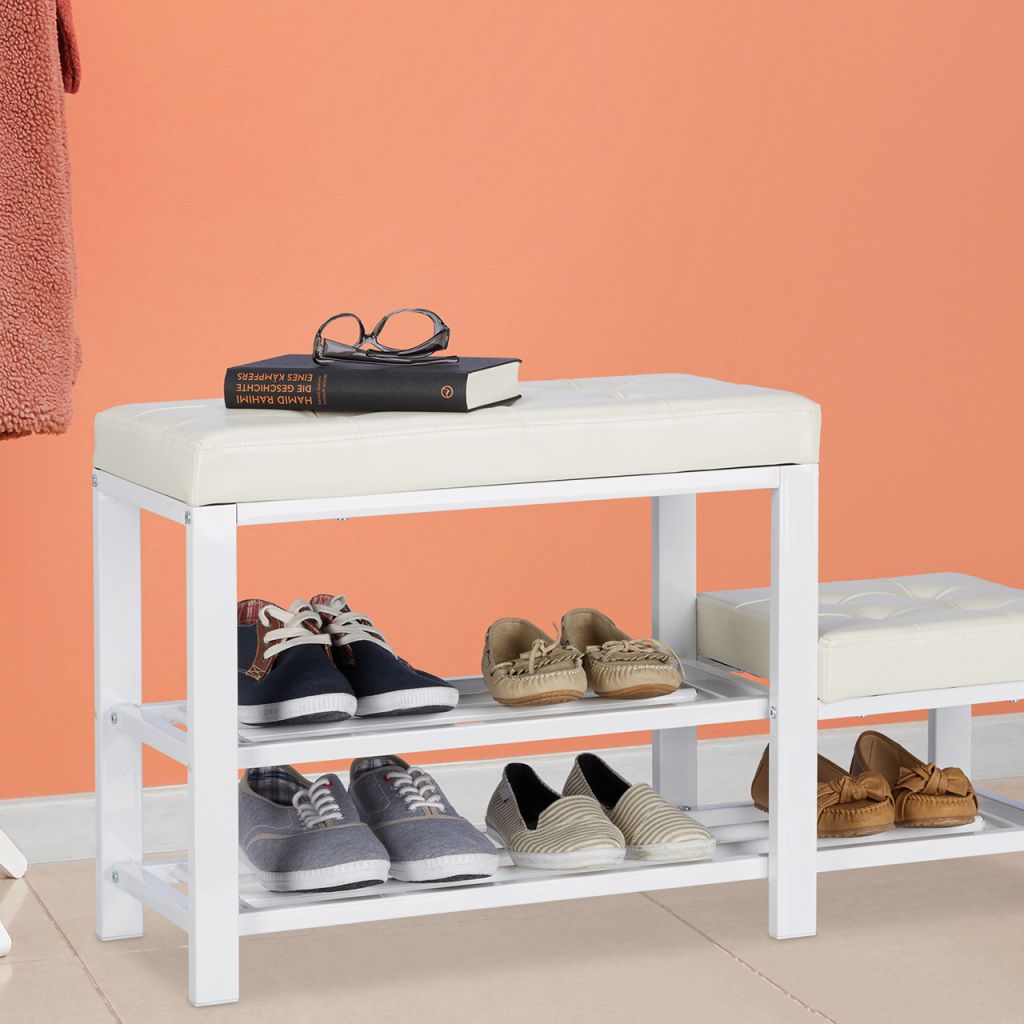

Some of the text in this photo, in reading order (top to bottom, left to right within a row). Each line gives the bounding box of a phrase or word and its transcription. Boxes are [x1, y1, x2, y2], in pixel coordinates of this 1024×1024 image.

[237, 372, 313, 382] EINES KÄMPFERS
[236, 383, 312, 393] DIE GESCHICHTE
[236, 395, 313, 405] HAMID RAHIMI
